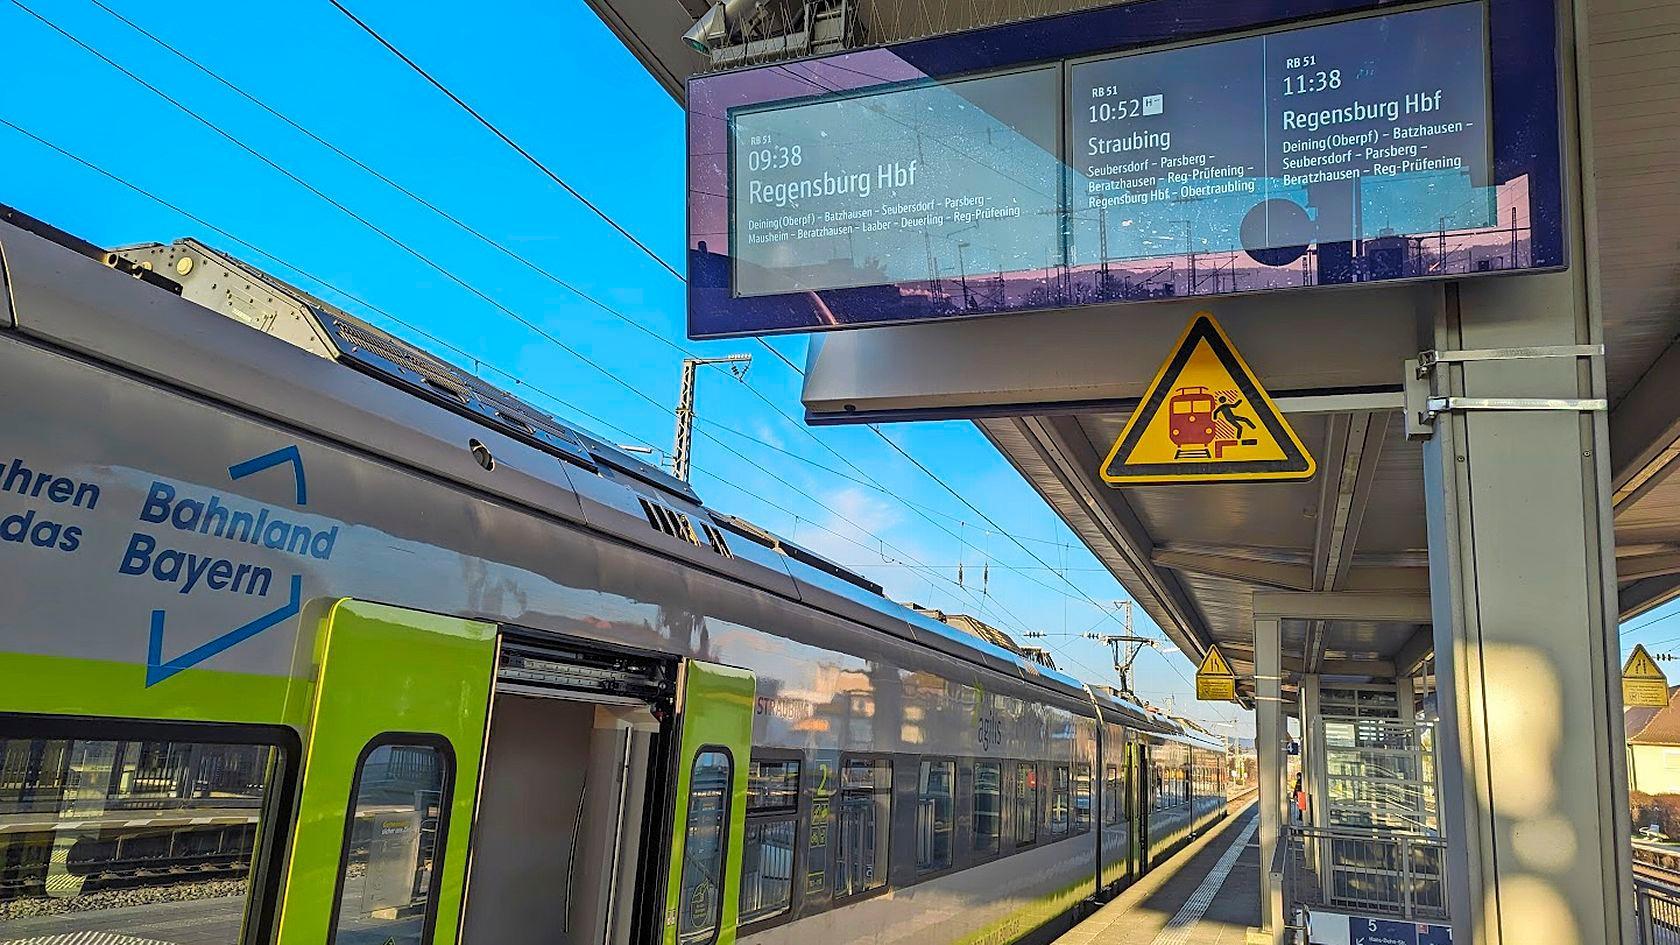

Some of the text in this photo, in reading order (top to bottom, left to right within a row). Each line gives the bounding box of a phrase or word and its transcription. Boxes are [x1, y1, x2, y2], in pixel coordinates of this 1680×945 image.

[1286, 55, 1316, 69] RB 51
[1092, 85, 1118, 98] RB 51
[1283, 69, 1342, 96] 11:38
[1089, 99, 1140, 123] 10:52
[1283, 90, 1442, 131] Regensburg Hbf
[751, 134, 771, 145] RB 51
[1088, 130, 1171, 156] Straubing
[1283, 129, 1379, 154] Deining(Oberpf)
[1393, 122, 1462, 140] Batzhausen
[749, 145, 802, 171] 09:38
[1088, 158, 1149, 177] Seubersdorf
[1161, 154, 1206, 168] Parsberg
[1283, 150, 1352, 170] Seubersdorf
[1366, 144, 1417, 160] Parsberg
[1283, 166, 1360, 186] Beratzhausen
[1373, 156, 1462, 176] Reg-Prüfening
[750, 160, 917, 207] Regensburg Hbf
[1089, 175, 1156, 193] Beratzhausen
[1168, 165, 1244, 184] Reg-Prüfening
[1089, 191, 1148, 209] Regensburg
[1150, 188, 1170, 201] Hbf
[1181, 179, 1255, 198] Obertraubling
[748, 213, 815, 230] Deining(Oberpf)
[824, 208, 872, 222] Batzhausen
[882, 199, 935, 215] Seubersdorf
[945, 196, 984, 209] Parsberg
[748, 231, 788, 244] Mausheim
[797, 225, 853, 239] Beratzhausen
[862, 220, 891, 232] Laaber
[901, 214, 943, 228] Deuerling
[954, 206, 1020, 223] Reg-Prüfening
[0, 510, 83, 552] das
[139, 481, 339, 560] Bahnland
[119, 533, 272, 597] Bayern
[978, 710, 1001, 751] agilis
[817, 763, 828, 796] 2
[1368, 919, 1377, 932] 5
